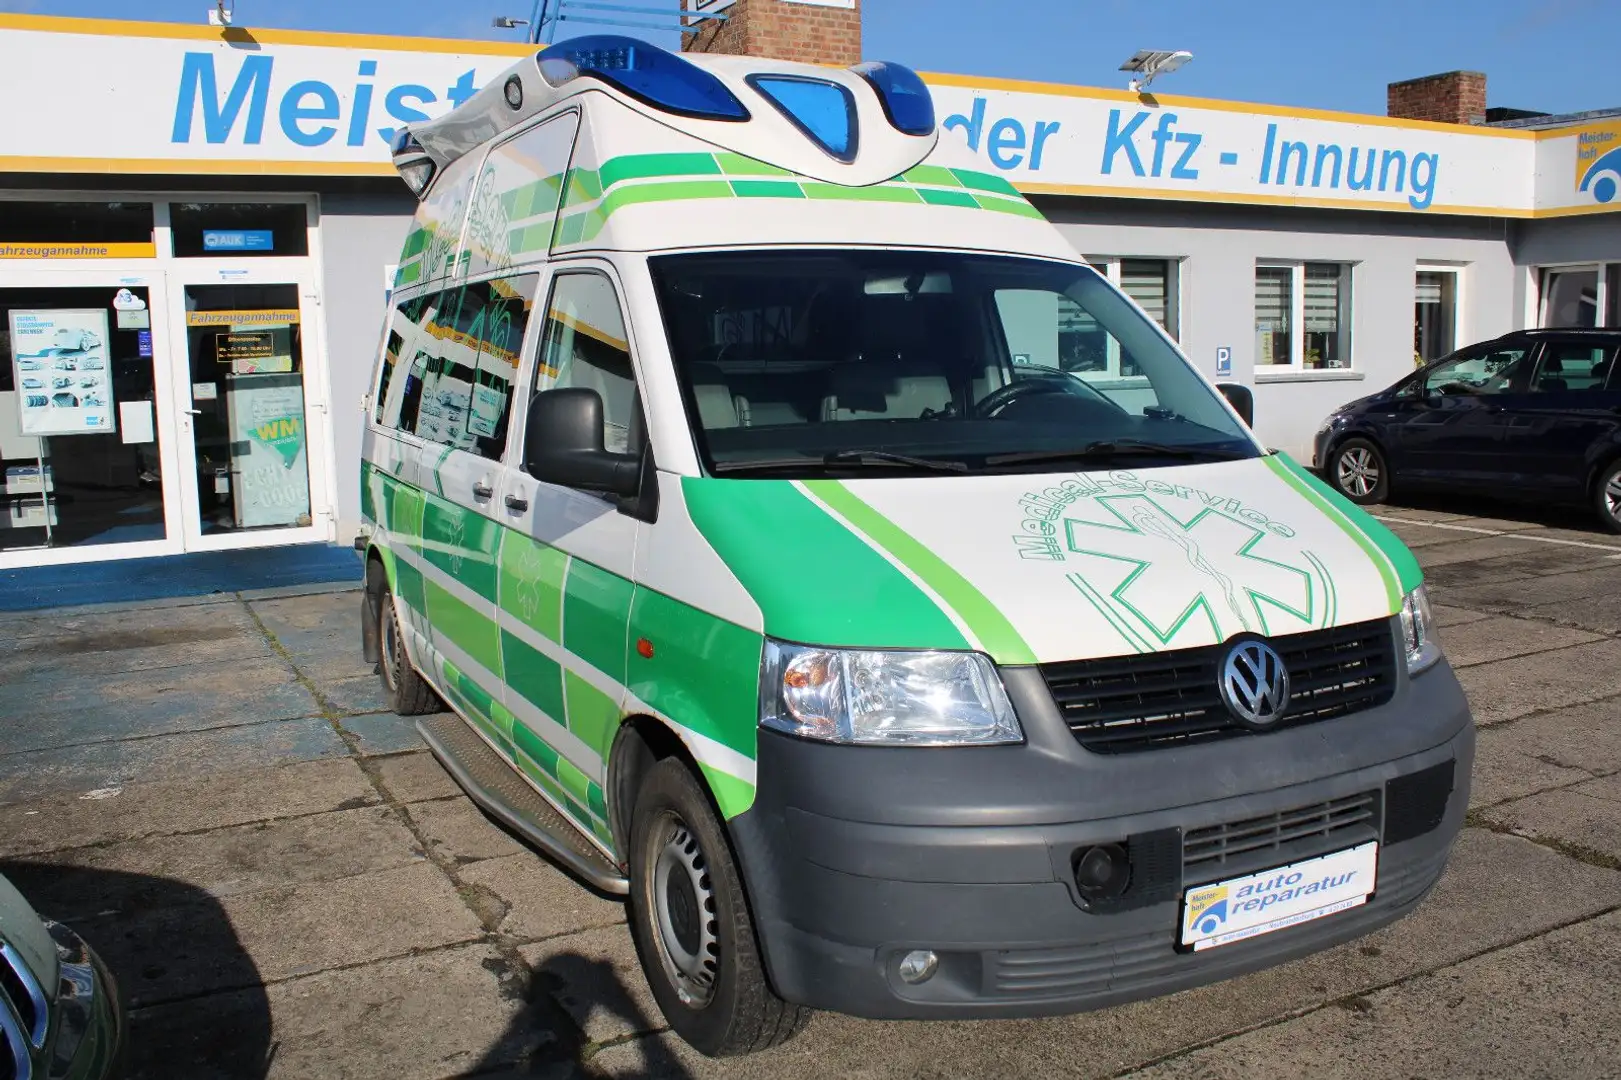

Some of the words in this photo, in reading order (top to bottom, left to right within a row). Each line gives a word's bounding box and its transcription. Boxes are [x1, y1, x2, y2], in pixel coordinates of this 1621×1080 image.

[1100, 109, 1202, 180] Kfz
[1258, 123, 1439, 210] Innung
[190, 312, 296, 324] Fahrzeugannahme
[1217, 348, 1229, 370] P
[256, 417, 299, 440] WM
[1232, 870, 1358, 915] reparatur
[1235, 872, 1304, 898] auto
